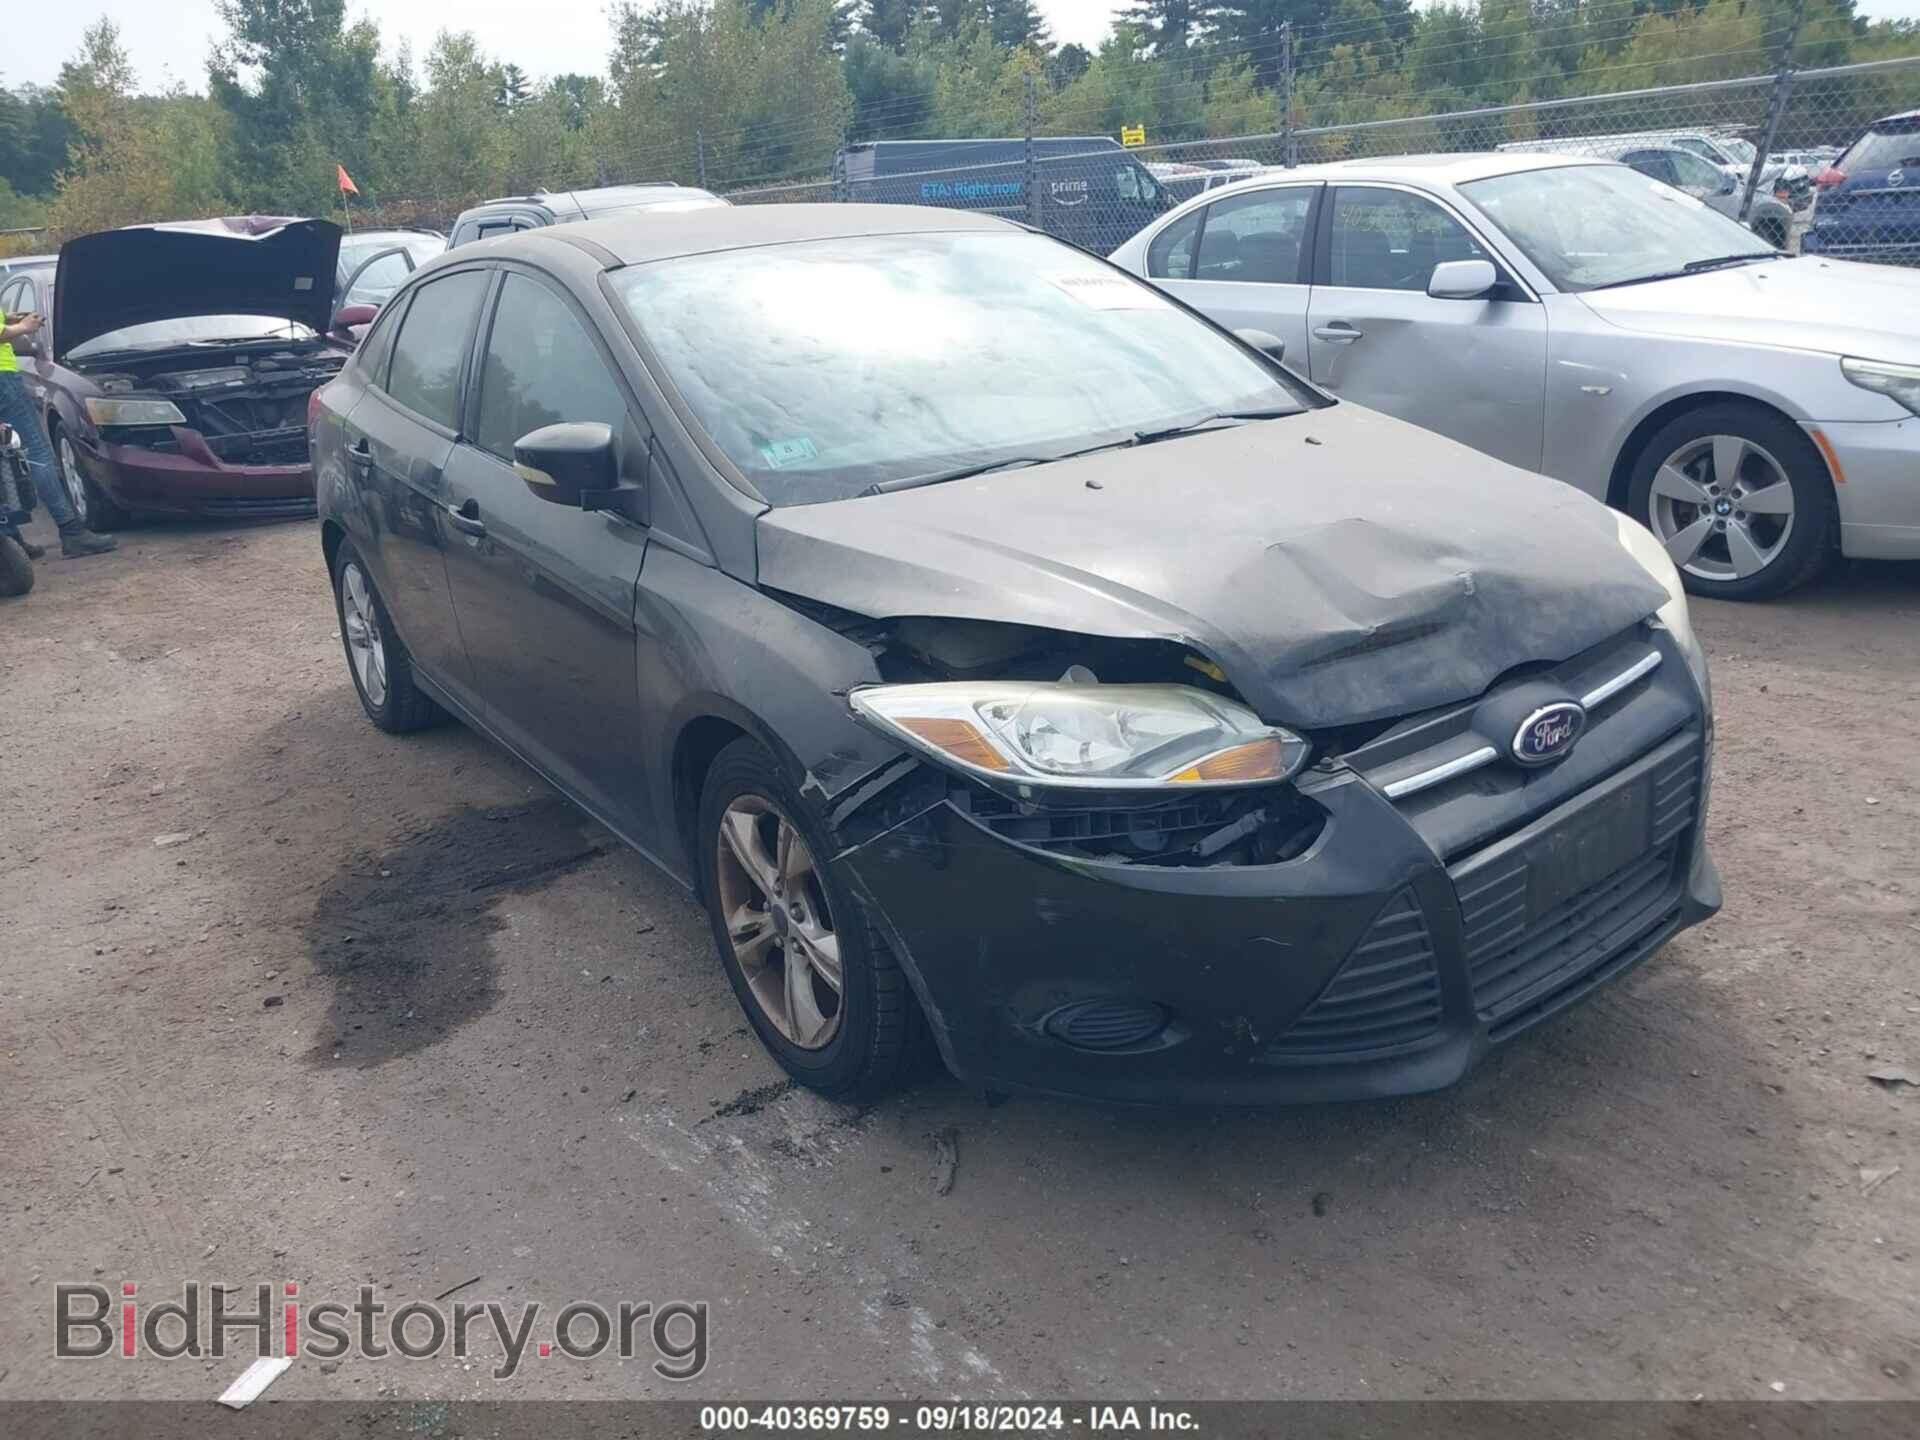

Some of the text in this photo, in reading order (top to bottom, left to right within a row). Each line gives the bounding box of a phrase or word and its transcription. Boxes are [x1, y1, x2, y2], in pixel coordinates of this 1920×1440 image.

[954, 180, 991, 199] Right
[1051, 178, 1088, 195] prime
[1534, 713, 1574, 751] Ford
